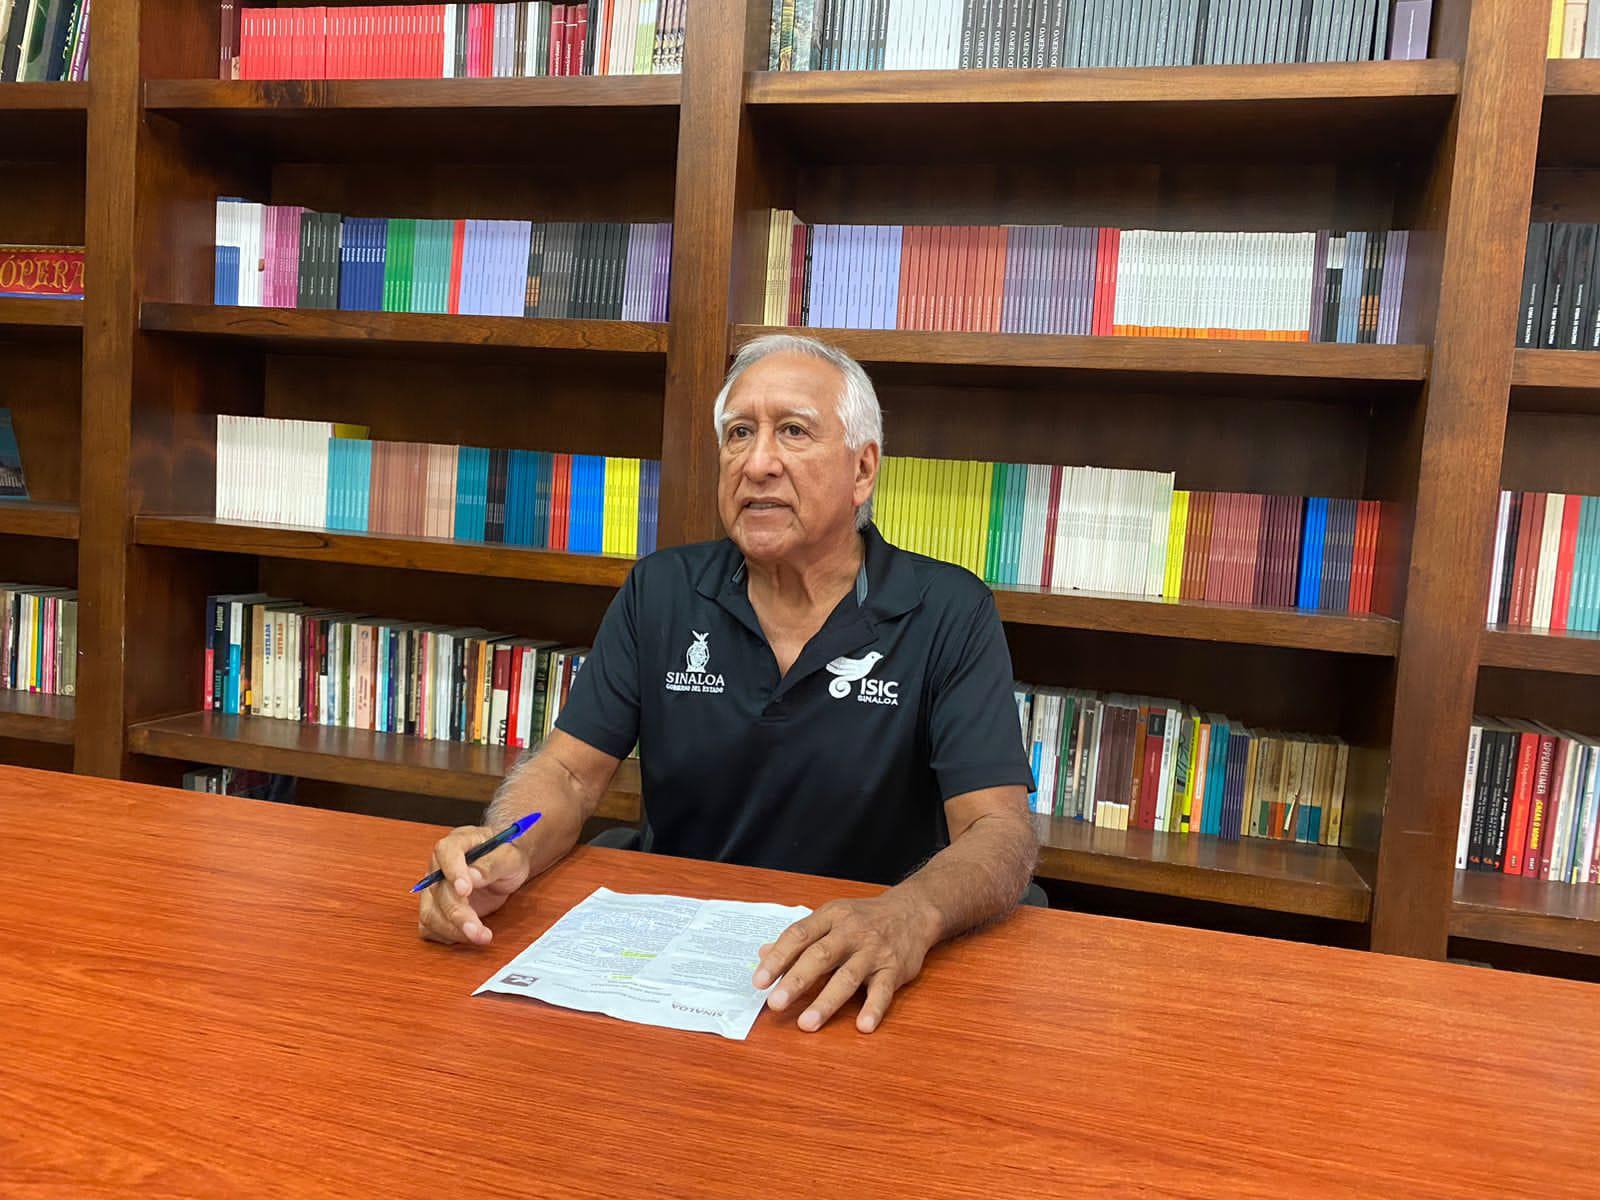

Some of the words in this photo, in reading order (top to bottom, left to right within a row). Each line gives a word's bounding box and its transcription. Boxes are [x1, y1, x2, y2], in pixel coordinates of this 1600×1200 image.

[963, 30, 971, 55] NERVO
[977, 31, 985, 56] NERVO
[993, 30, 1001, 56] NERVO
[1008, 30, 1016, 56] NERVO
[1023, 31, 1031, 56] NERVO
[1038, 27, 1046, 53] NERVO
[1052, 29, 1060, 55] NERVO
[0, 254, 85, 292] ÓPERA
[665, 671, 725, 687] SINALOA
[860, 678, 899, 698] ISIC
[857, 694, 899, 706] SINALOA
[1536, 742, 1552, 795] OPPENHEIMER
[671, 1003, 723, 1017] SINALOA
